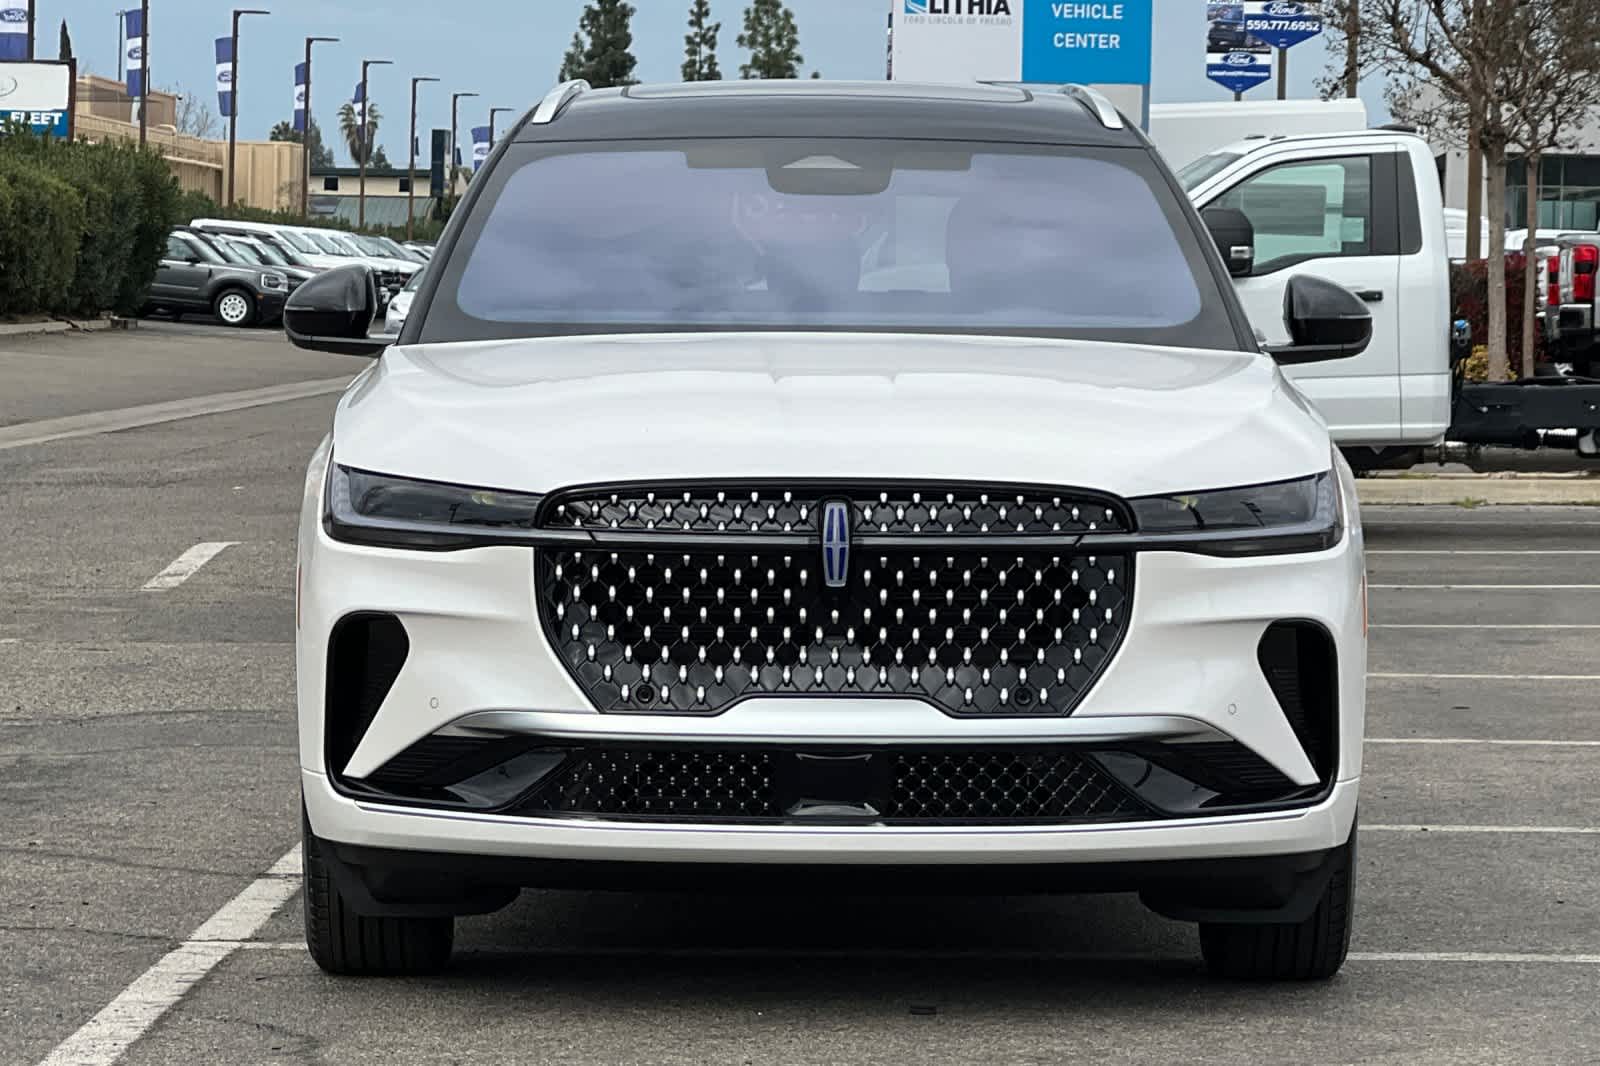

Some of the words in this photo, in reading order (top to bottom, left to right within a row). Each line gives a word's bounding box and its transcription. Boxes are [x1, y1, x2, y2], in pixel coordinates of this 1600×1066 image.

[929, 0, 1011, 15] LITHIA
[1051, 3, 1124, 20] VEHICLE
[1246, 20, 1320, 31] 559.777.6952
[1053, 32, 1121, 49] CENTER
[11, 111, 63, 125] FLEET
